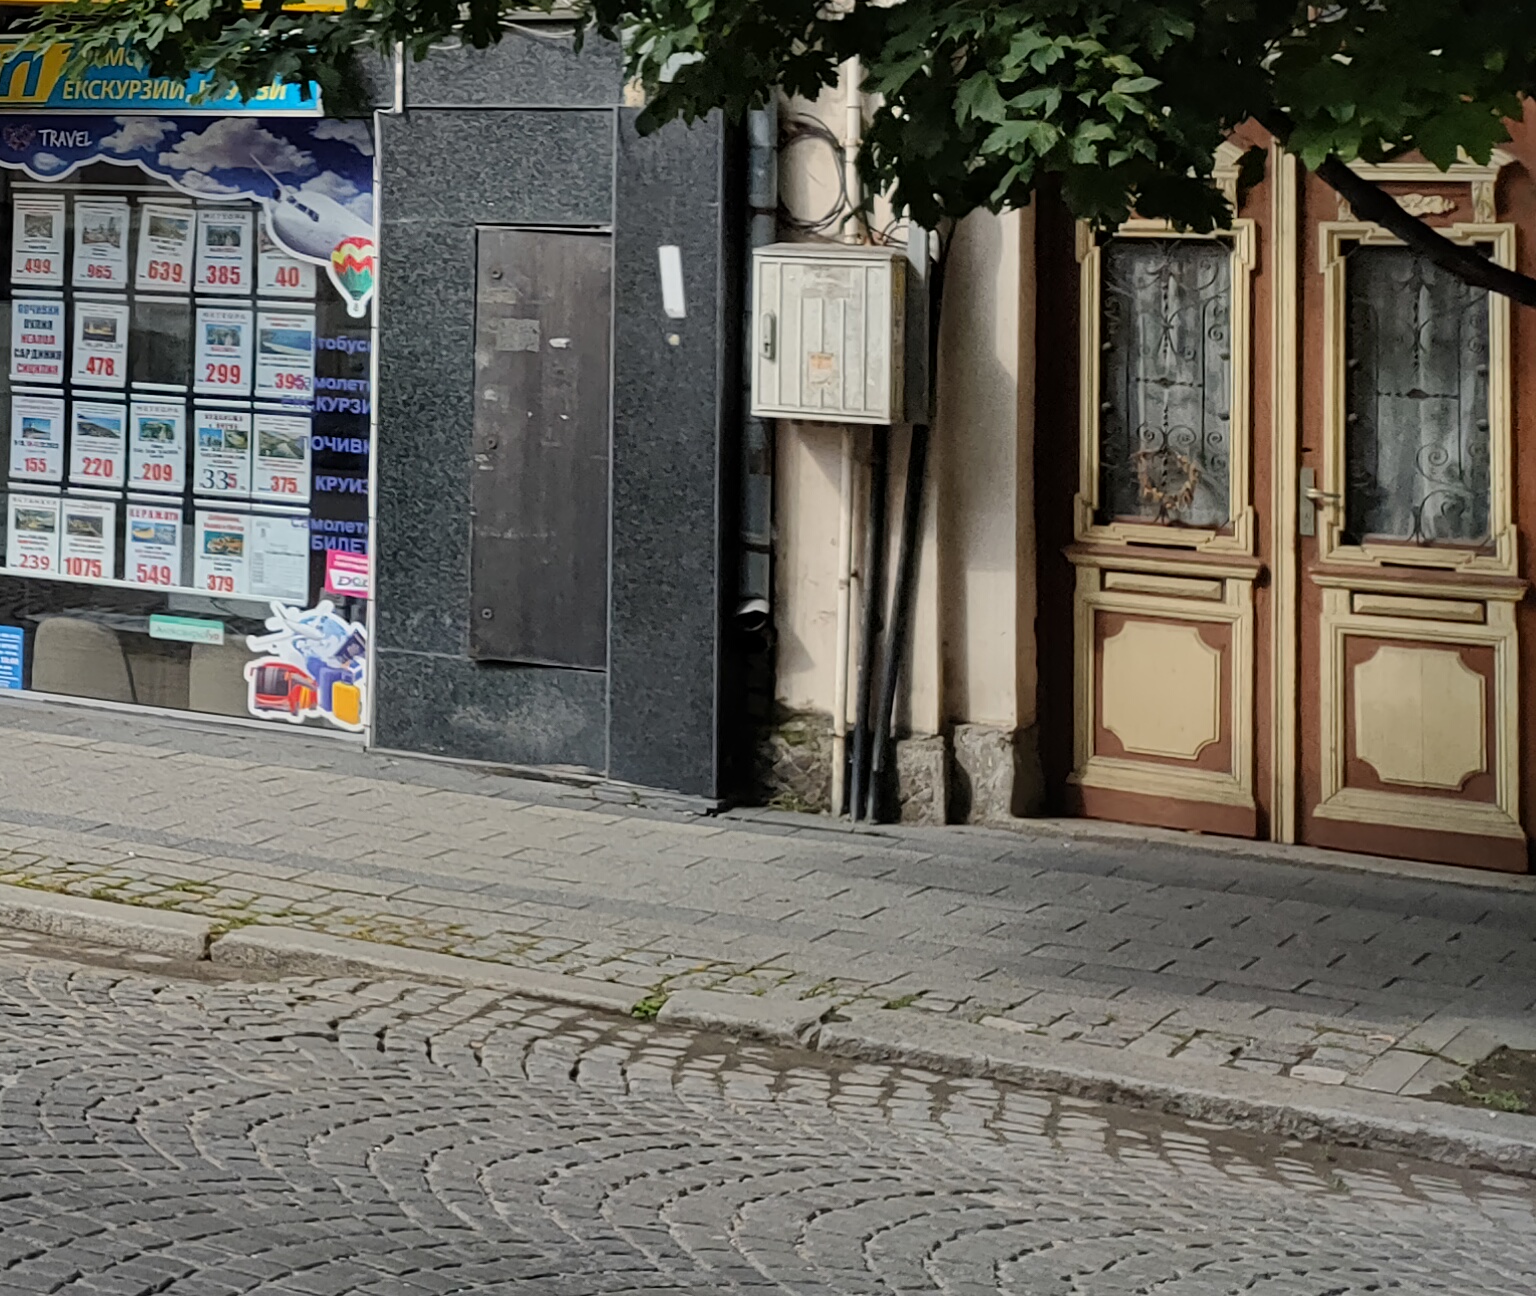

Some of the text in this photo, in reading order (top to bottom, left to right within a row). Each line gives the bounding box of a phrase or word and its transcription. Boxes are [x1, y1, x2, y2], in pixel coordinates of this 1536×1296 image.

[37, 129, 93, 148] TRAVEL
[24, 258, 52, 274] 499
[147, 259, 183, 283] 639
[206, 265, 241, 285] 385
[85, 356, 115, 376] 478
[204, 363, 241, 384] 299
[24, 457, 47, 473] 155
[82, 456, 113, 478] 220
[142, 463, 173, 482] 209
[199, 468, 238, 490] 335
[270, 475, 298, 493] 375
[19, 553, 50, 570] 239
[63, 557, 103, 578] 1075
[136, 563, 172, 586] 549
[207, 574, 234, 592] 379
